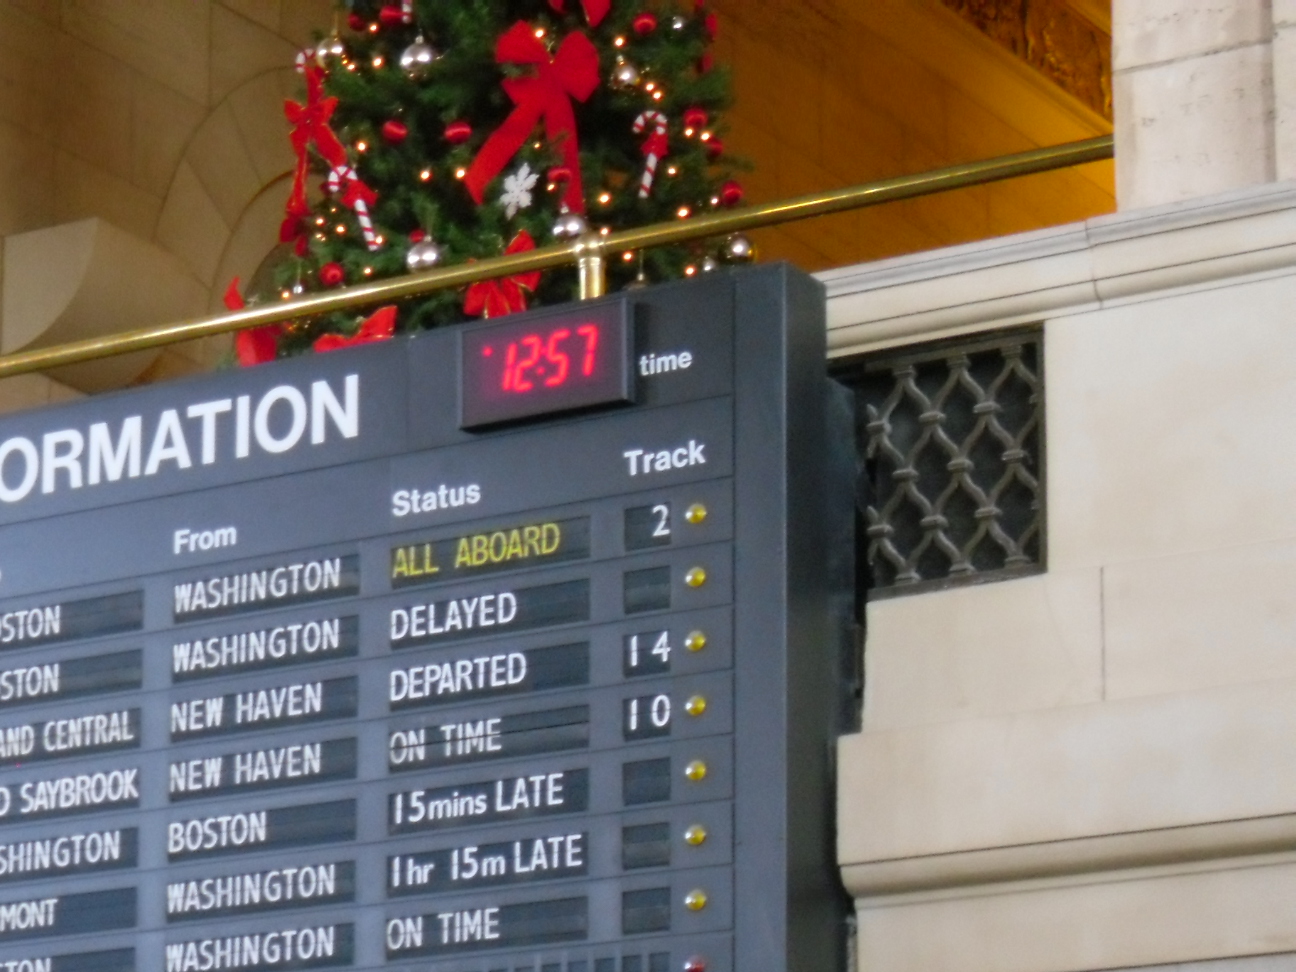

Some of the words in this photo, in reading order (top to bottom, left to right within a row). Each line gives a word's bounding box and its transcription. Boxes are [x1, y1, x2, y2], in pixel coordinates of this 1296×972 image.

[501, 323, 599, 394] 12:57
[639, 348, 692, 377] time
[174, 526, 237, 555] From
[392, 482, 481, 517] Status
[624, 440, 706, 477] Track
[174, 558, 341, 615] WASHINGTON
[392, 543, 439, 579] ALL
[455, 521, 561, 569] ABOARD
[652, 504, 671, 537] 2
[173, 618, 340, 674] WASHINGTON
[391, 592, 517, 640] DELAYED
[44, 711, 134, 752] CENTRAL
[171, 696, 223, 734] NEW
[236, 682, 322, 724] HAVEN
[389, 651, 527, 702] DEPARTED
[20, 769, 139, 814] SAYBROOK
[169, 758, 221, 793] NEW
[235, 743, 321, 785] HAVEN
[389, 731, 425, 765] ON
[440, 718, 502, 758] TIME
[168, 811, 267, 854] BOSTON
[393, 790, 487, 825] 15mins
[495, 772, 564, 813] LATE
[167, 864, 336, 914] WASHINGTON
[392, 856, 434, 886] 1hr
[450, 845, 506, 881] 15m
[513, 834, 583, 873] LATE
[387, 916, 422, 950] ON
[438, 907, 500, 945] TIME
